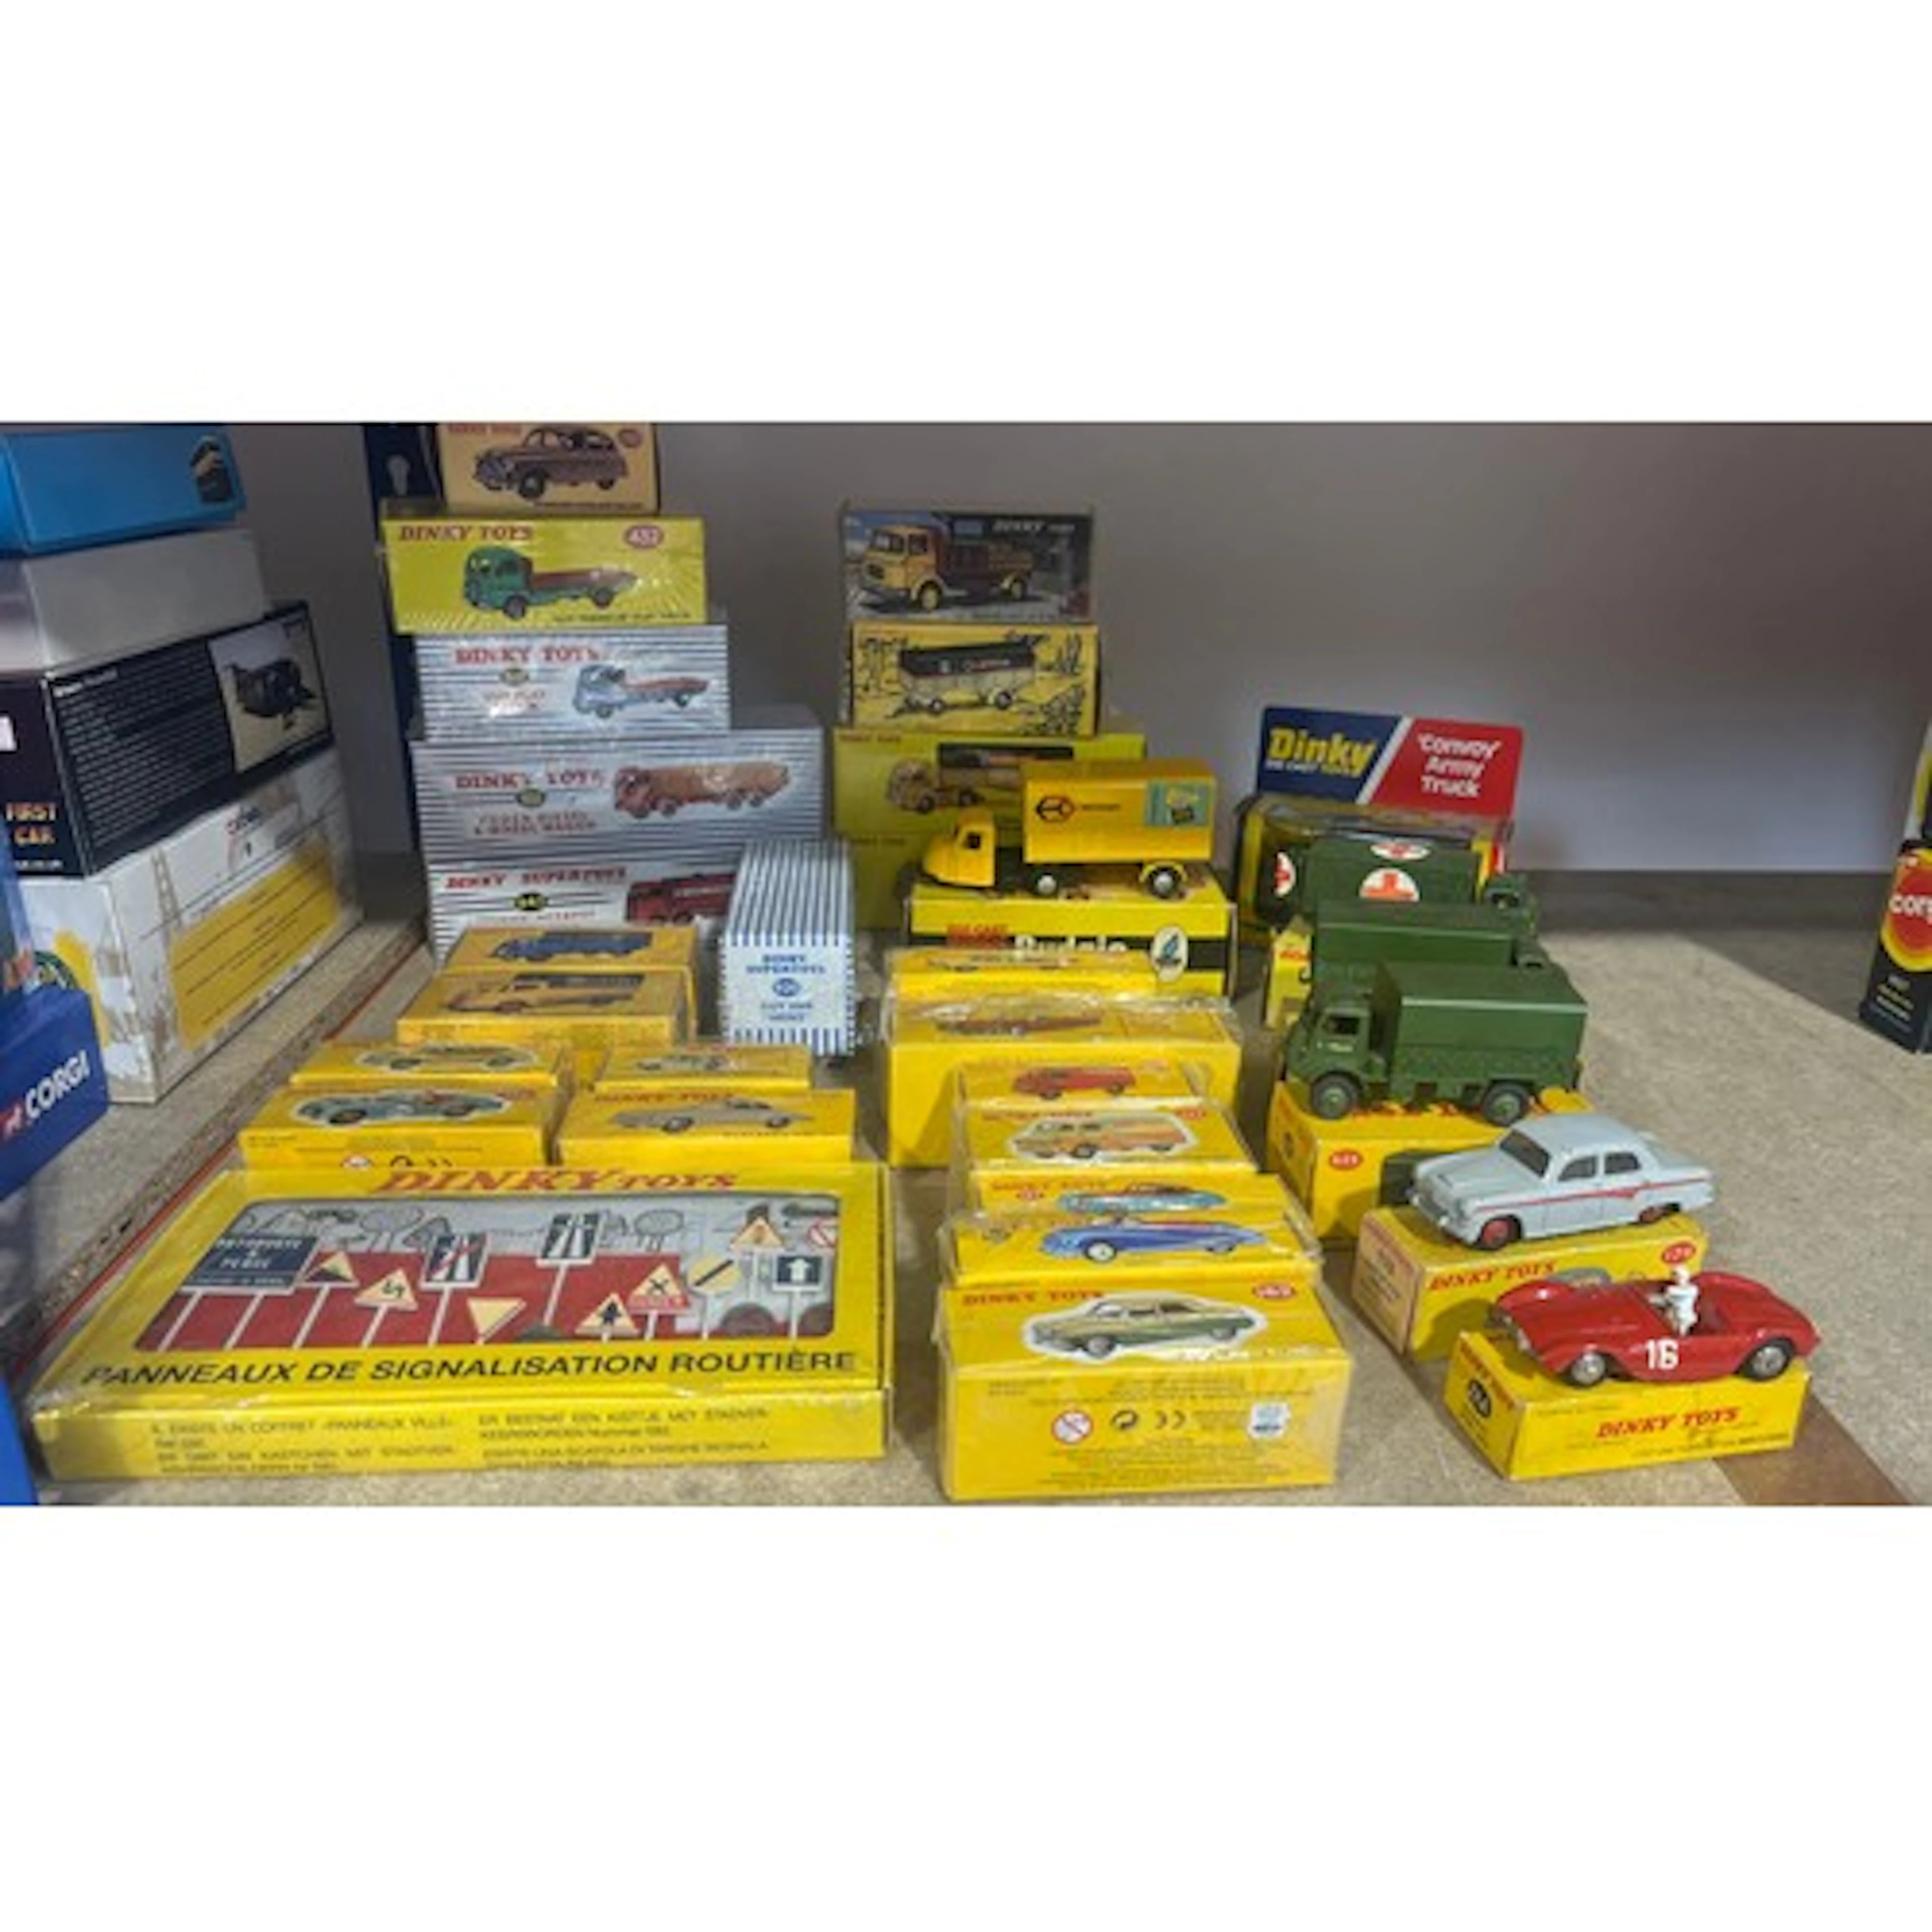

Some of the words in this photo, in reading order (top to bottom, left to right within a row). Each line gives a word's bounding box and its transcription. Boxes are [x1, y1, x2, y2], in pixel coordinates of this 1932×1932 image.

[400, 525, 471, 540] DINKY
[479, 525, 533, 540] TOYS
[455, 646, 531, 664] DINKY
[543, 644, 600, 662] TOYS
[1268, 728, 1378, 779] Dinky
[1425, 755, 1485, 779] Army
[1420, 775, 1481, 797] Truck
[445, 872, 505, 890] DINKY
[26, 1049, 91, 1119] CORGI
[374, 1170, 627, 1191] DINKY
[621, 1174, 738, 1189] TOYS
[1430, 1267, 1499, 1291] DINKY
[1506, 1259, 1556, 1279] TOYS
[961, 1292, 1036, 1307] DINKY
[1644, 1338, 1679, 1370] 16
[82, 1363, 298, 1386] PANNEAUX
[305, 1361, 363, 1381] DE
[369, 1354, 659, 1382] SIGNALISATION
[668, 1347, 858, 1374] ROUTIÈRE
[1595, 1414, 1677, 1438] DINKY
[1682, 1407, 1740, 1426] TOYS
